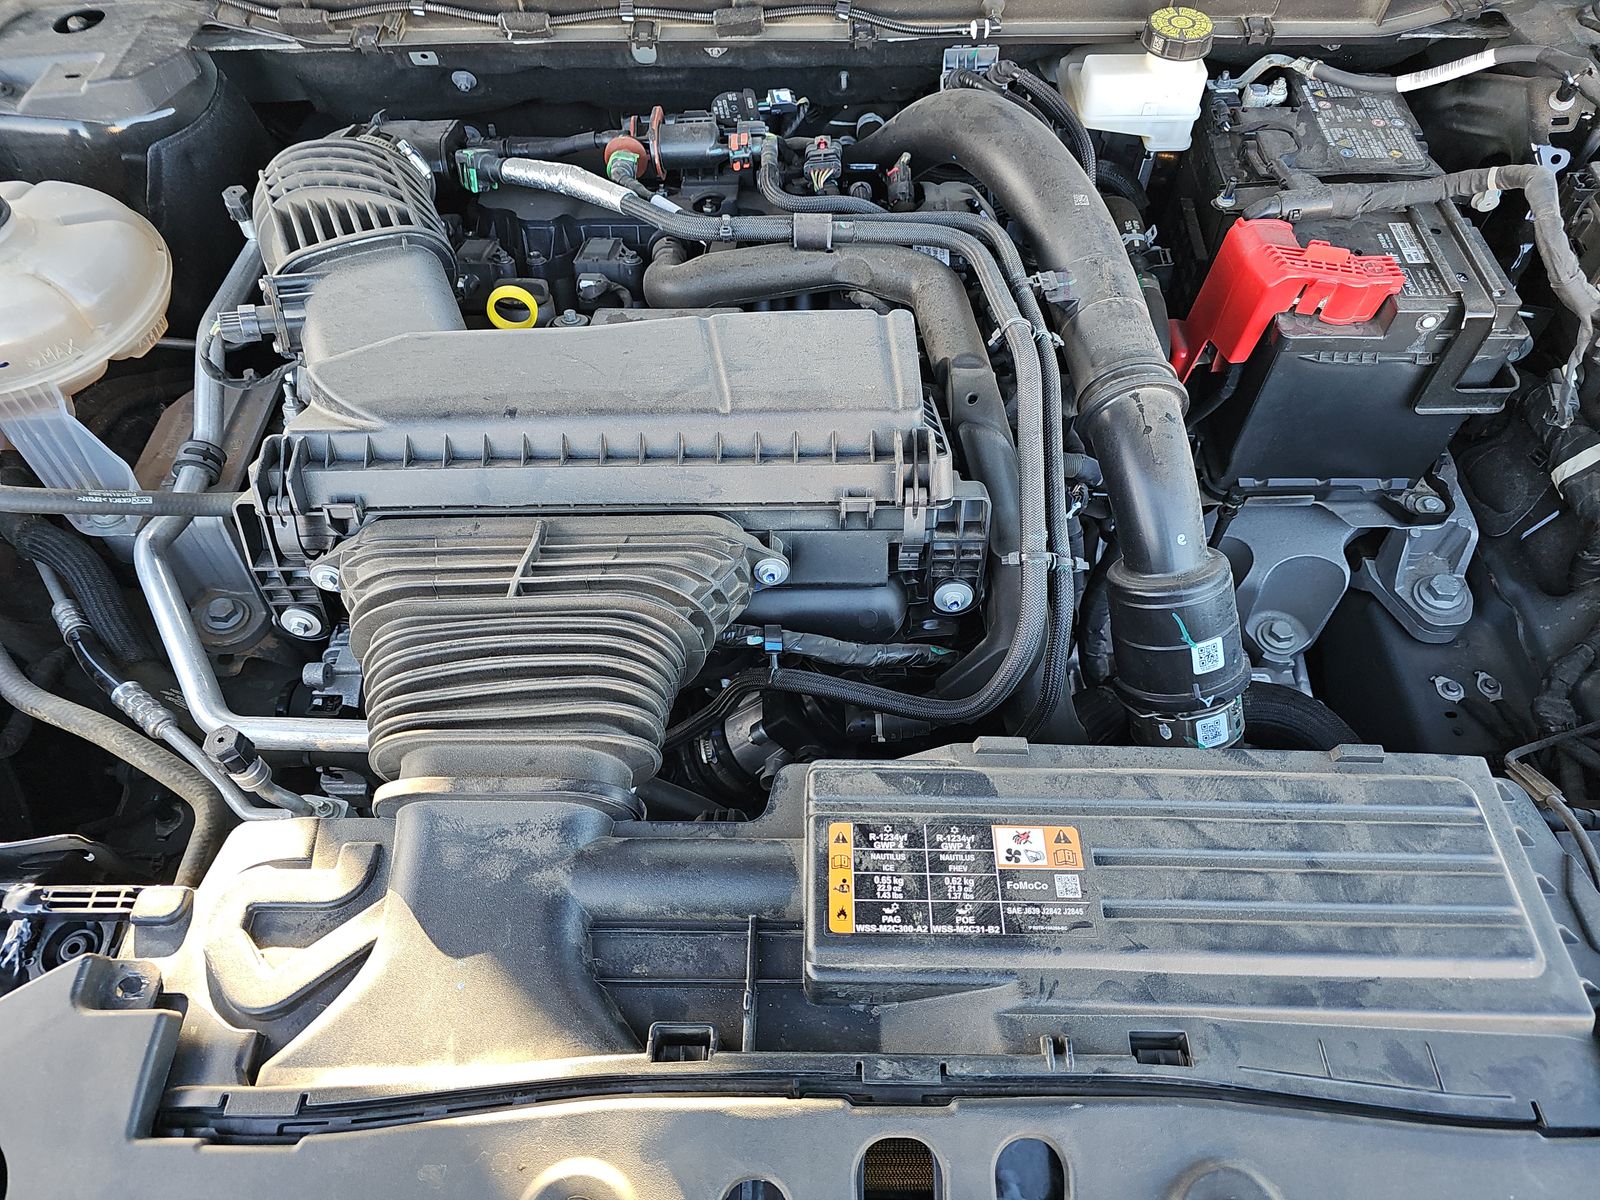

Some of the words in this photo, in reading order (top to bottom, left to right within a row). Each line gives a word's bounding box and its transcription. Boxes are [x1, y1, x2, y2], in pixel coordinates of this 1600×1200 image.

[40, 338, 84, 364] MAX
[869, 833, 908, 842] R-1234yf
[936, 834, 975, 843] R-1234yf
[873, 841, 896, 849] GWP
[898, 841, 905, 849] 4
[941, 842, 963, 850] GWP
[965, 842, 972, 850] 4
[870, 853, 906, 861] NAUTILUS
[882, 864, 895, 872] ICE
[873, 876, 892, 884] 0.65
[893, 876, 904, 887] kg
[944, 877, 962, 885] 0.62
[963, 877, 975, 888] kg
[1006, 881, 1049, 890] FoMoCo
[1006, 907, 1023, 915] SAE
[881, 916, 902, 924] PAG
[955, 917, 976, 925] POE
[856, 925, 929, 933] WSS-M2C300-A2
[932, 926, 1001, 934] WSS-M2C31-B2
